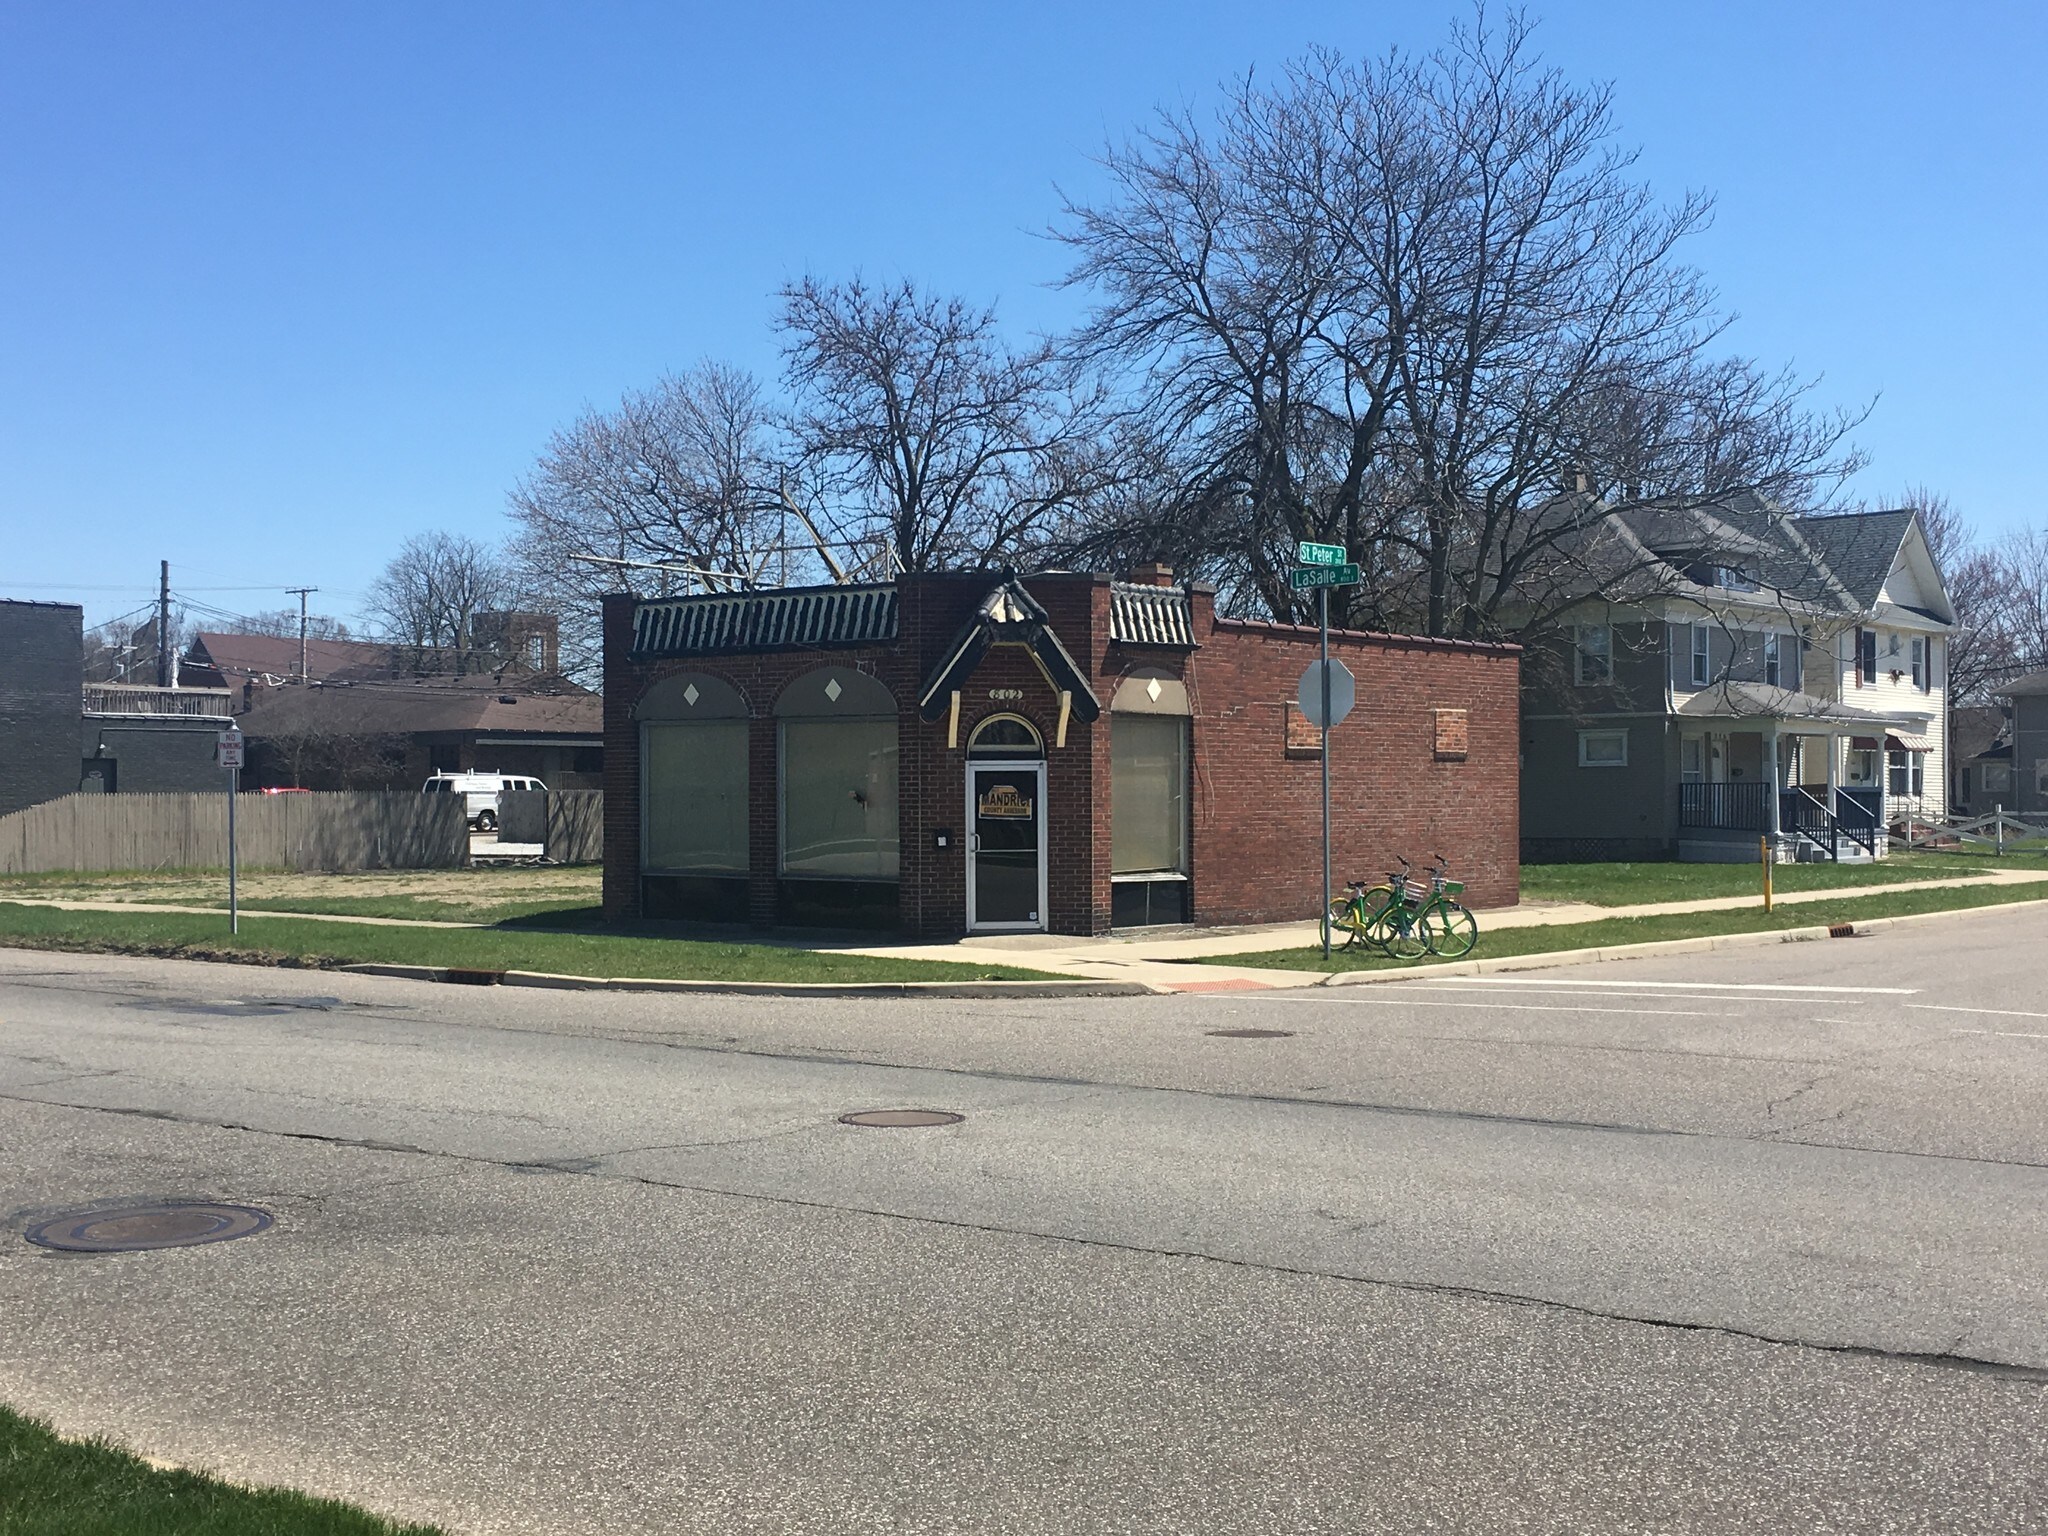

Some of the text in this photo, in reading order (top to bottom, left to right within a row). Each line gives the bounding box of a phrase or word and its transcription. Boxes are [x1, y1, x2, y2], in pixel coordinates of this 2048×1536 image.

[1301, 545, 1311, 561] St
[1312, 546, 1334, 563] Peter
[1295, 569, 1336, 587] LaSalle
[993, 689, 1019, 700] 802
